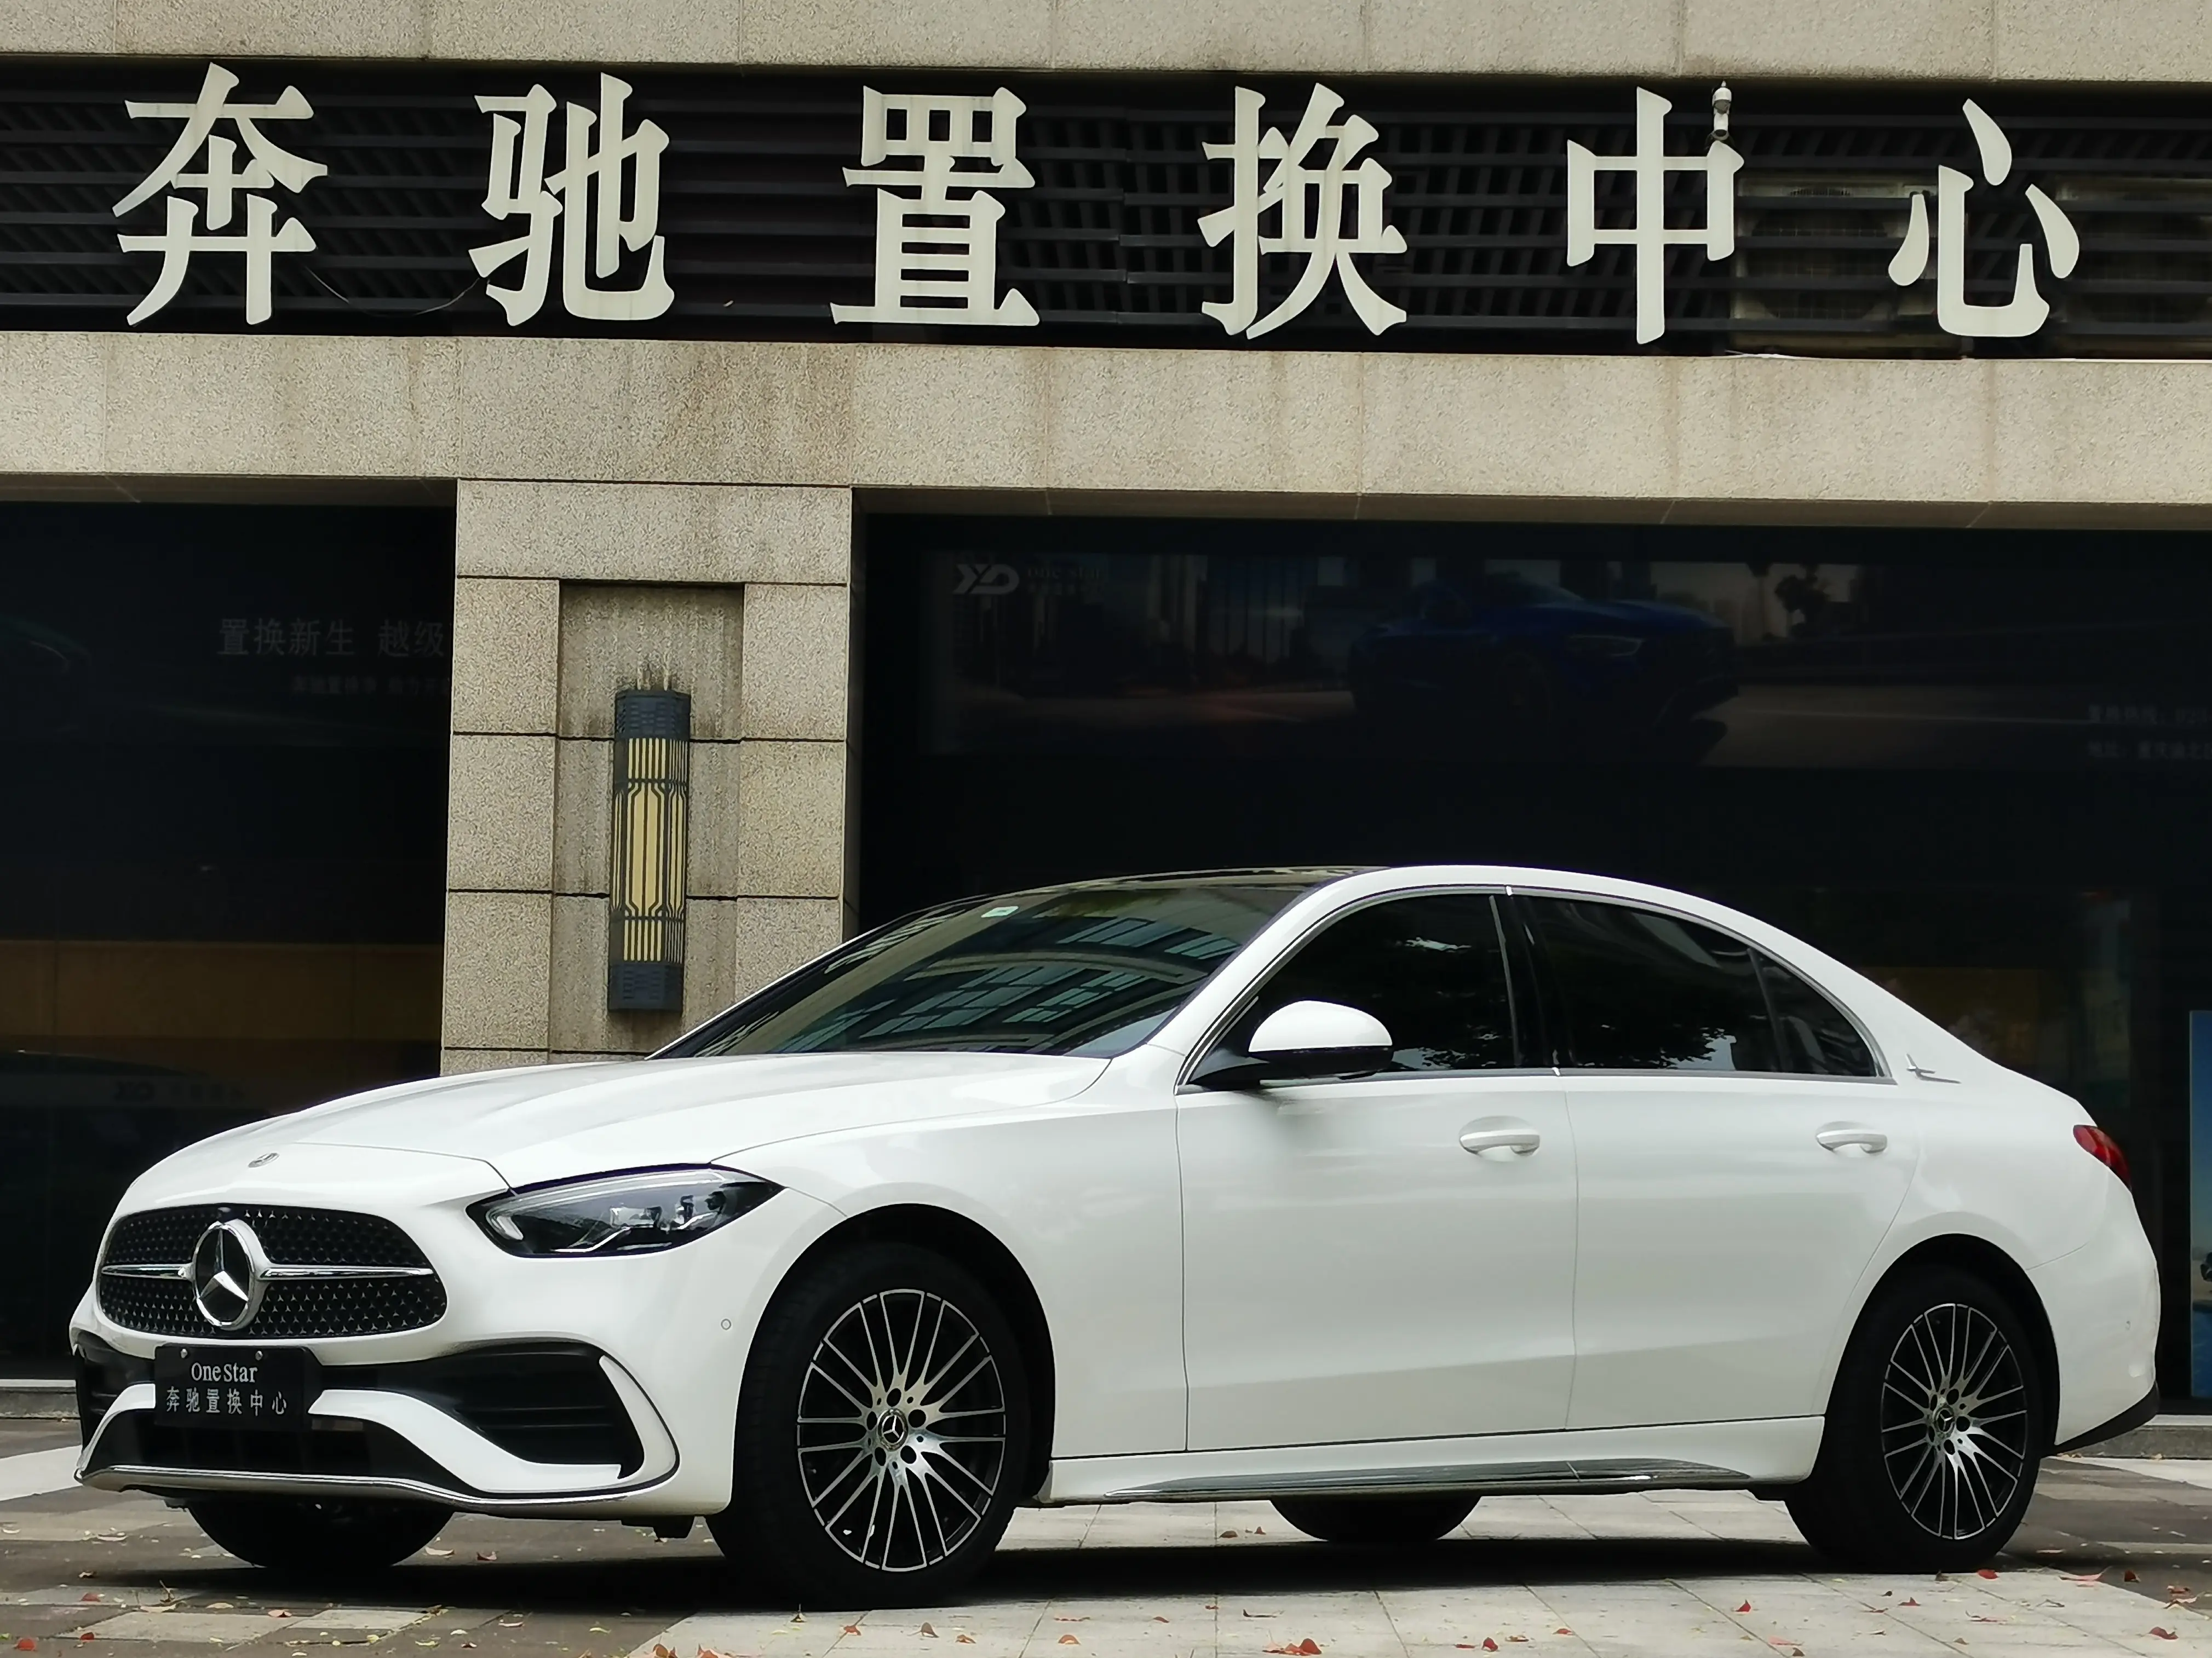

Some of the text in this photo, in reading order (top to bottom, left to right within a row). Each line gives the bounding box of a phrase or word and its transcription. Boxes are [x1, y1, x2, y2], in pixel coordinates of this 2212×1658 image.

[113, 64, 2079, 344] 奔驰置换中心
[217, 617, 444, 658] 置换新生 越级
[166, 1386, 287, 1417] 奔驰置换中心
